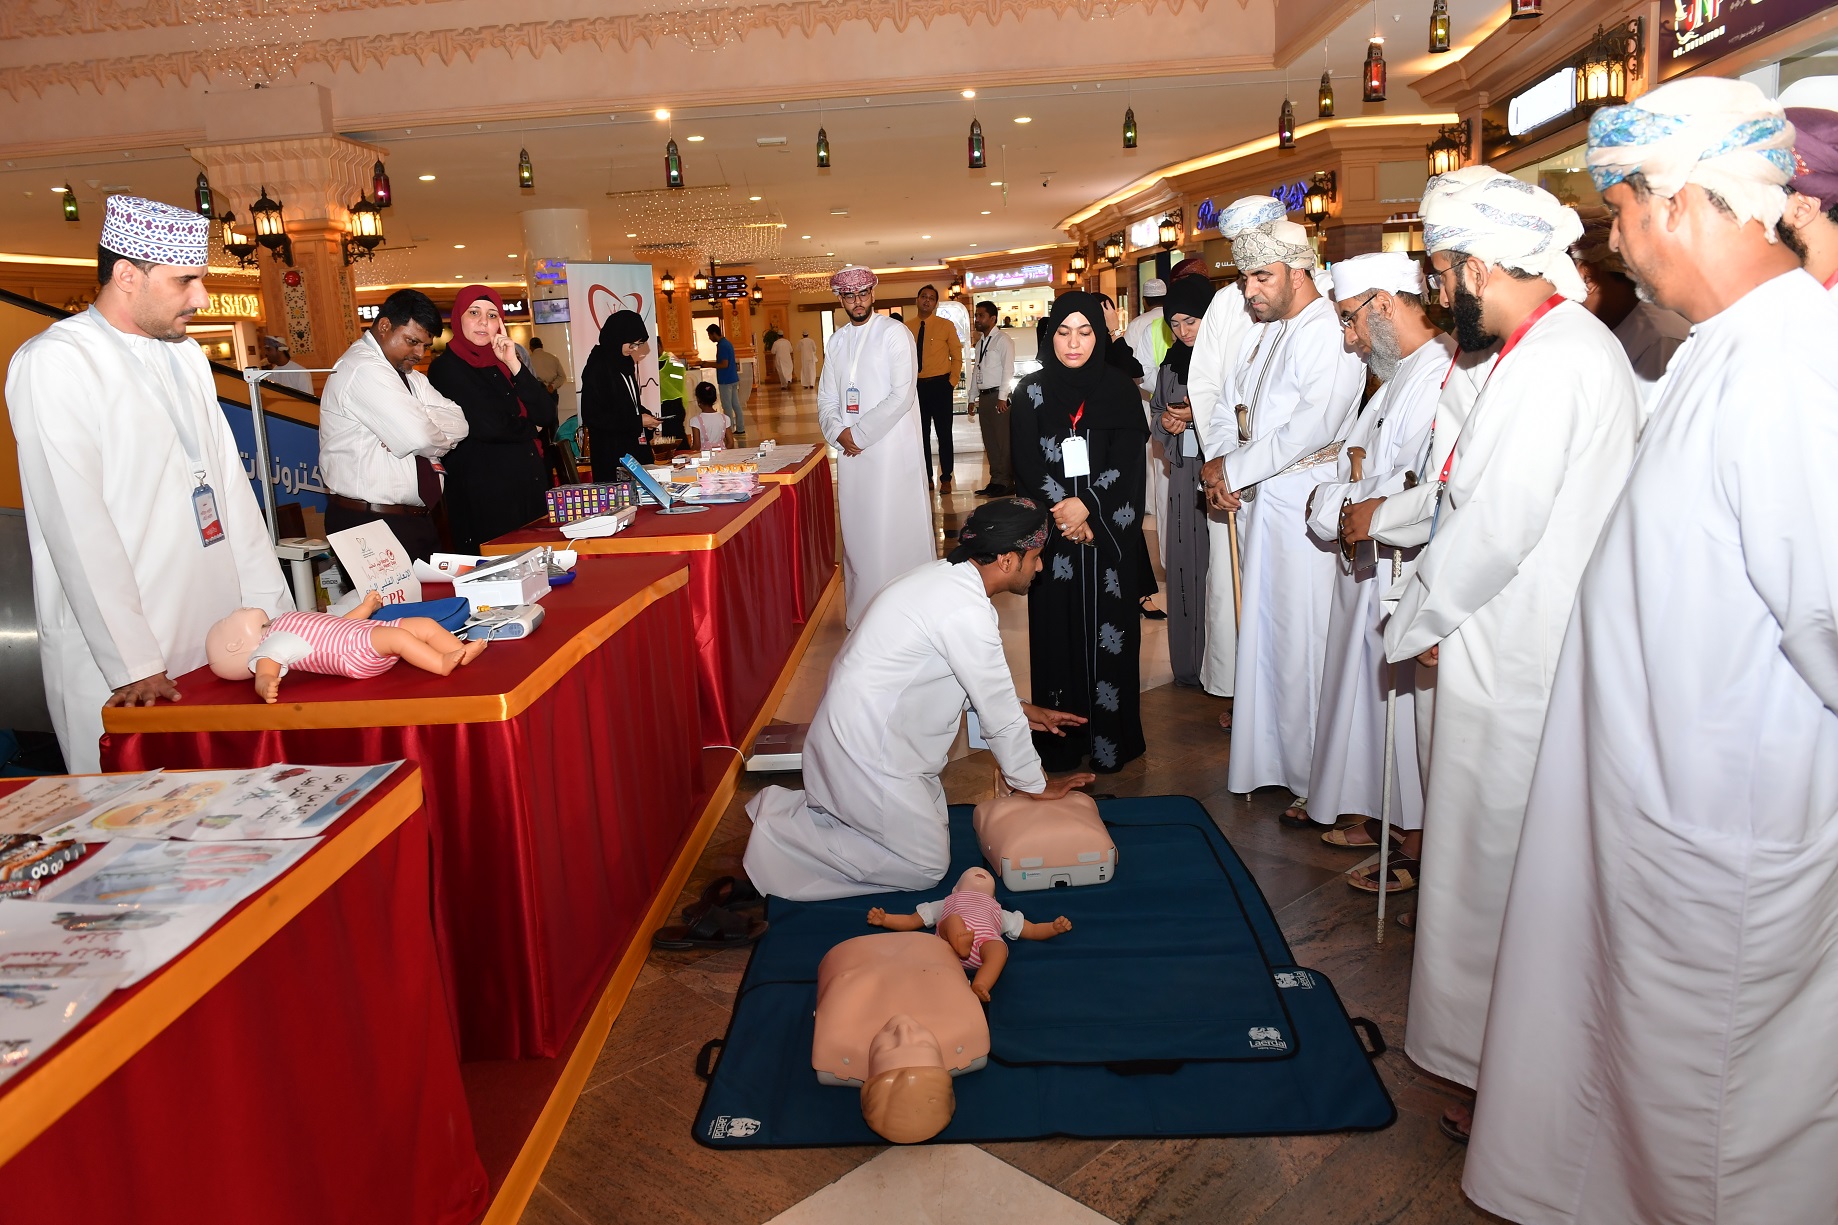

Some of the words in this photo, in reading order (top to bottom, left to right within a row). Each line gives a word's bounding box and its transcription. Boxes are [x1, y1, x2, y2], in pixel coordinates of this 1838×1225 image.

[221, 293, 258, 317] SHOP
[381, 589, 406, 608] CPR
[1249, 1039, 1288, 1049] Laerdal
[712, 1115, 731, 1139] Laerdal
